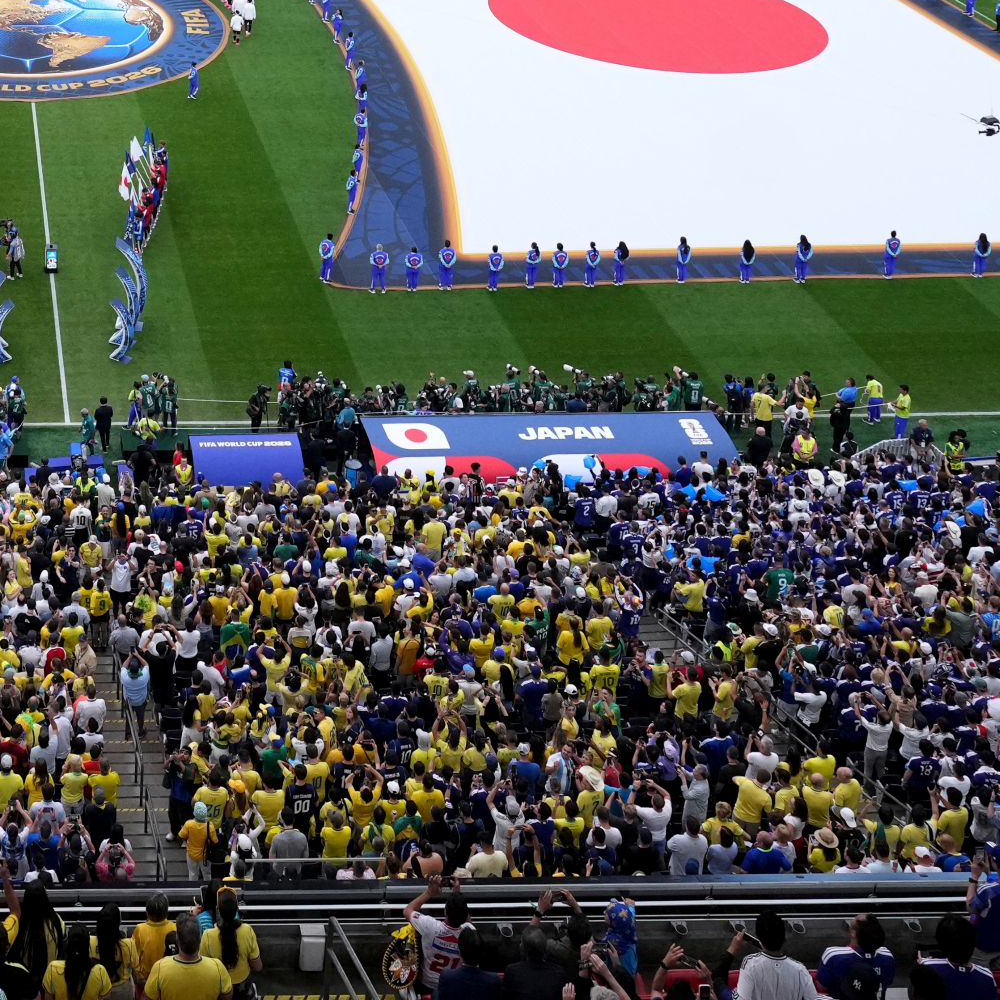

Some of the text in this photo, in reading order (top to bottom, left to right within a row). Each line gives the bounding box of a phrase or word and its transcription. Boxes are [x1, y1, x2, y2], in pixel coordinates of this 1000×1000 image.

[181, 8, 210, 35] FIFA
[36, 82, 83, 91] CUP
[87, 64, 162, 88] 2026
[518, 426, 615, 440] JAPAN
[893, 499, 902, 509] 15
[917, 498, 927, 509] 13
[584, 506, 589, 516] 2
[76, 515, 86, 526] 10
[188, 530, 198, 539] 15
[632, 544, 638, 554] 3
[778, 578, 787, 590] 9
[100, 600, 106, 610] 9
[501, 606, 508, 616] 10
[603, 677, 614, 686] 10
[434, 686, 442, 695] 10
[401, 751, 411, 764] 10
[312, 777, 322, 789] 10
[207, 804, 221, 817] 26
[294, 800, 310, 814] 00
[430, 953, 460, 973] 21
